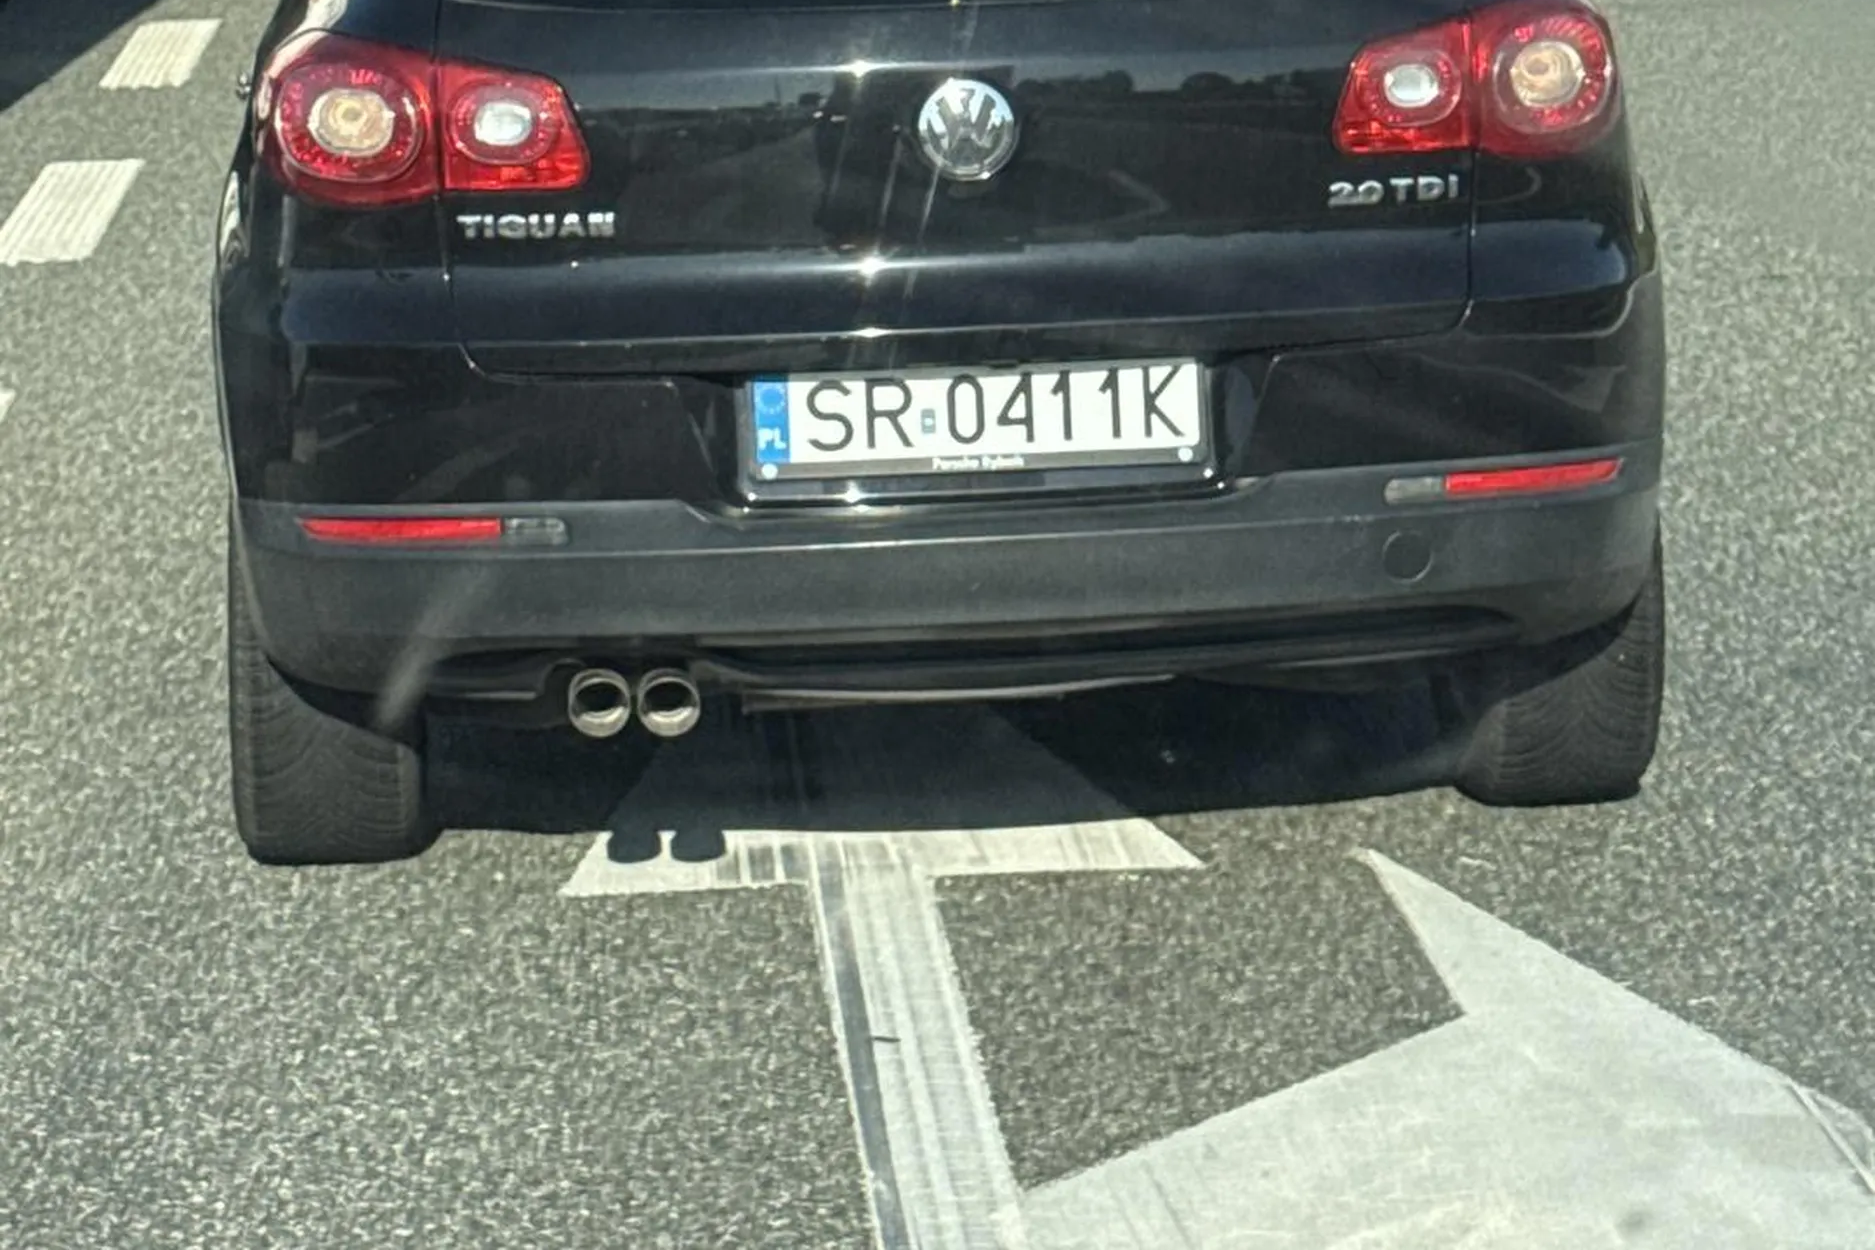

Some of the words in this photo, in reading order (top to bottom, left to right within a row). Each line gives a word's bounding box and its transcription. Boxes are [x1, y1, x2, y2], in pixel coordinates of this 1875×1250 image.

[1389, 173, 1459, 204] TDI
[456, 212, 616, 240] TIGUAN
[806, 379, 914, 452] SR
[946, 365, 1187, 445] 0411K
[757, 427, 787, 449] PL
